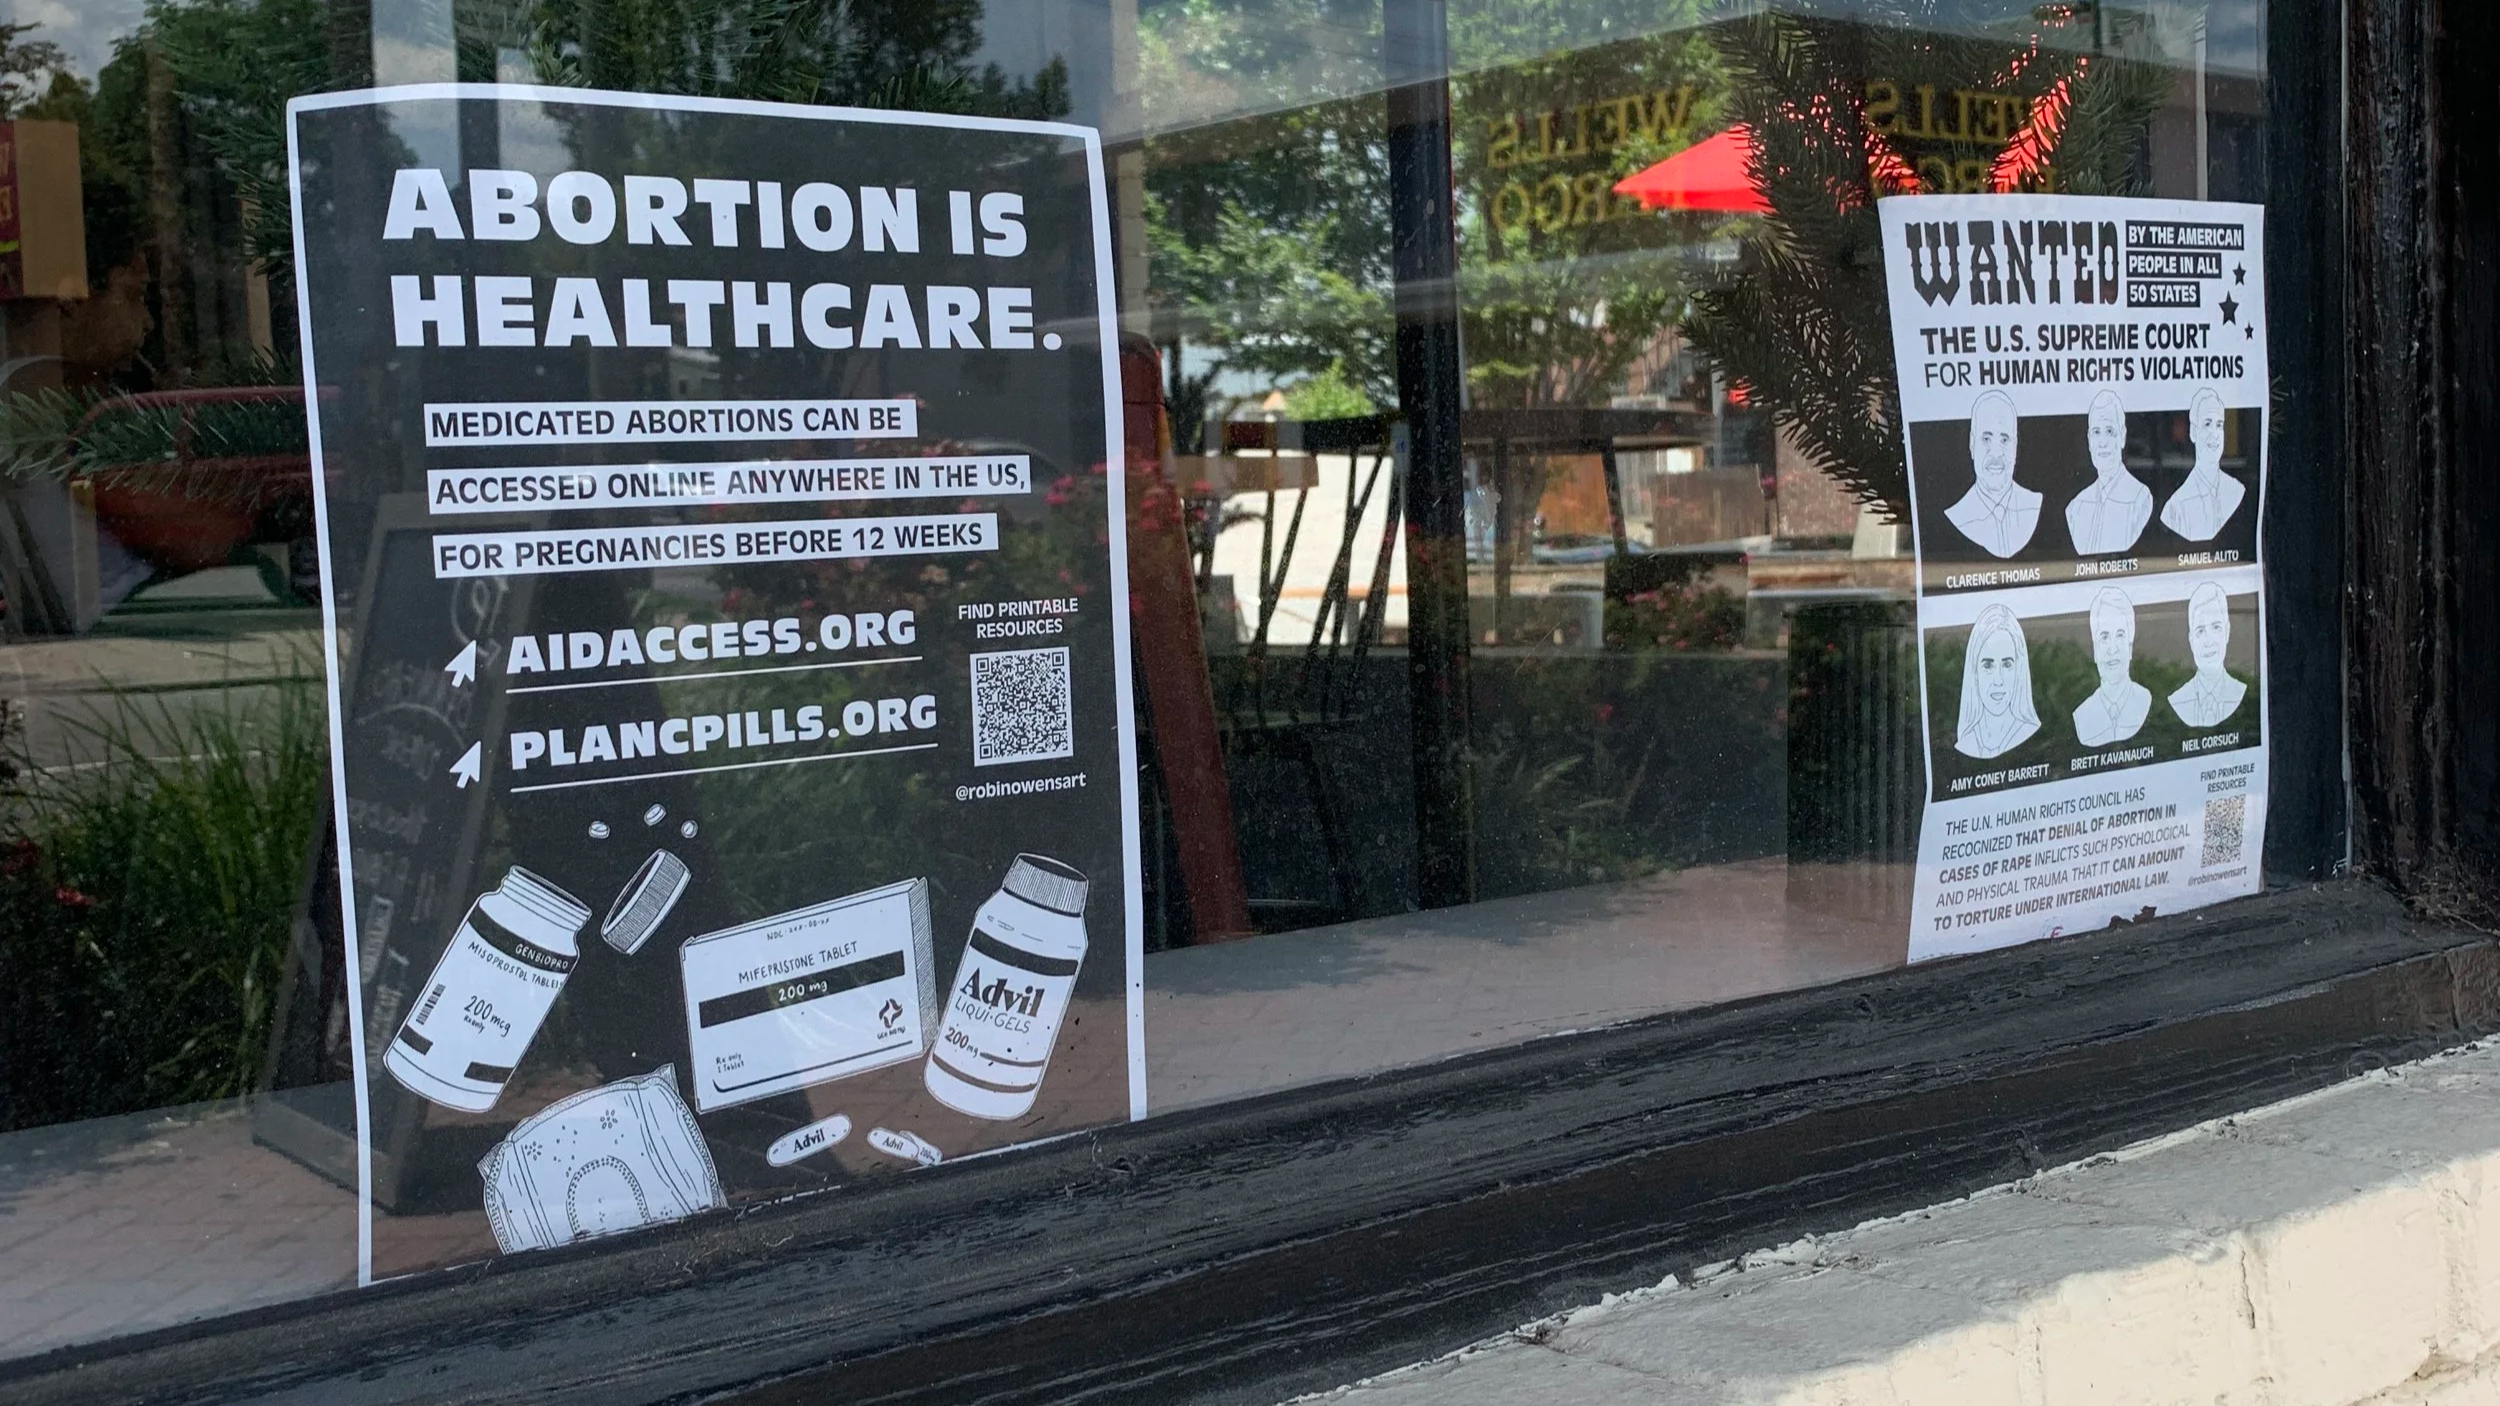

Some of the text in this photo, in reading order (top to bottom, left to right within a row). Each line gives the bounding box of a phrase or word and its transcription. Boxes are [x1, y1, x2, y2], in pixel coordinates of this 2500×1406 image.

[383, 168, 1027, 257] ABORTION IS
[2128, 225, 2243, 247] BY THE AMERICAN
[1905, 219, 2119, 307] WANTED
[2129, 256, 2219, 275] PEOPLE IN ALL
[2129, 284, 2197, 302] 50 STATES
[391, 275, 1063, 351] HEALTHCARE.
[1920, 323, 2210, 354] THE U.S. SUPREME COURT
[1924, 355, 2244, 388] FOR HUMAN RIGHTS VIOLATIONS
[431, 405, 902, 438] MEDICATED ABORTIONS CAN BE
[435, 462, 1026, 505] ACCESSED ONLINE ANYWHERE IN THE US,
[440, 523, 982, 571] FOR PREGNANCIES BEFORE 12 WEEKS
[2178, 550, 2239, 566] SAMUEL ALITO
[1946, 568, 2040, 589] CLARENCE THOMAS
[2075, 558, 2138, 576] JOHN ROBERTS
[958, 598, 1078, 620] FIND PRINTABLE
[506, 609, 916, 674] AIDACCESS.ORG
[976, 619, 1063, 638] RESOURCES
[510, 695, 937, 770] PLANCPILLS.ORG
[2182, 732, 2239, 753] NEIL GORSUCH
[2071, 747, 2153, 771] BRETT KAVANAUGH
[2200, 763, 2255, 781] FIND PRINTABLE
[955, 772, 1086, 800] @robinowensart
[1951, 764, 2049, 792] AMY CONEY BARRETT
[2207, 777, 2247, 793] RESOURCES
[1945, 787, 2145, 836] THE U.N. HUMAN RIGHTS COUNCIL HAS
[1942, 804, 2177, 861] RECOGNIZED THAT DENIAL OF ABORTION IN
[1939, 823, 2190, 885] CASES OF RAPE INFLICTS SUCH PSYCHOLOGICAL
[1936, 846, 2185, 908] AND PHYSICAL TRAUMA THAT IT CAN AMOUNT
[2188, 866, 2248, 887] @robinowensart
[1934, 870, 2170, 931] TO TORTURE UNDER INTERNATIONAL LAW.
[468, 940, 528, 981] MISOPROSTOL
[515, 943, 569, 970] GENBIOPRO
[738, 941, 858, 984] MIFEPRISTONE TABLET
[778, 981, 828, 1002] 200 mg
[960, 967, 1045, 1018] Advil
[793, 1128, 825, 1153] Advil
[882, 1136, 904, 1151] Advil
